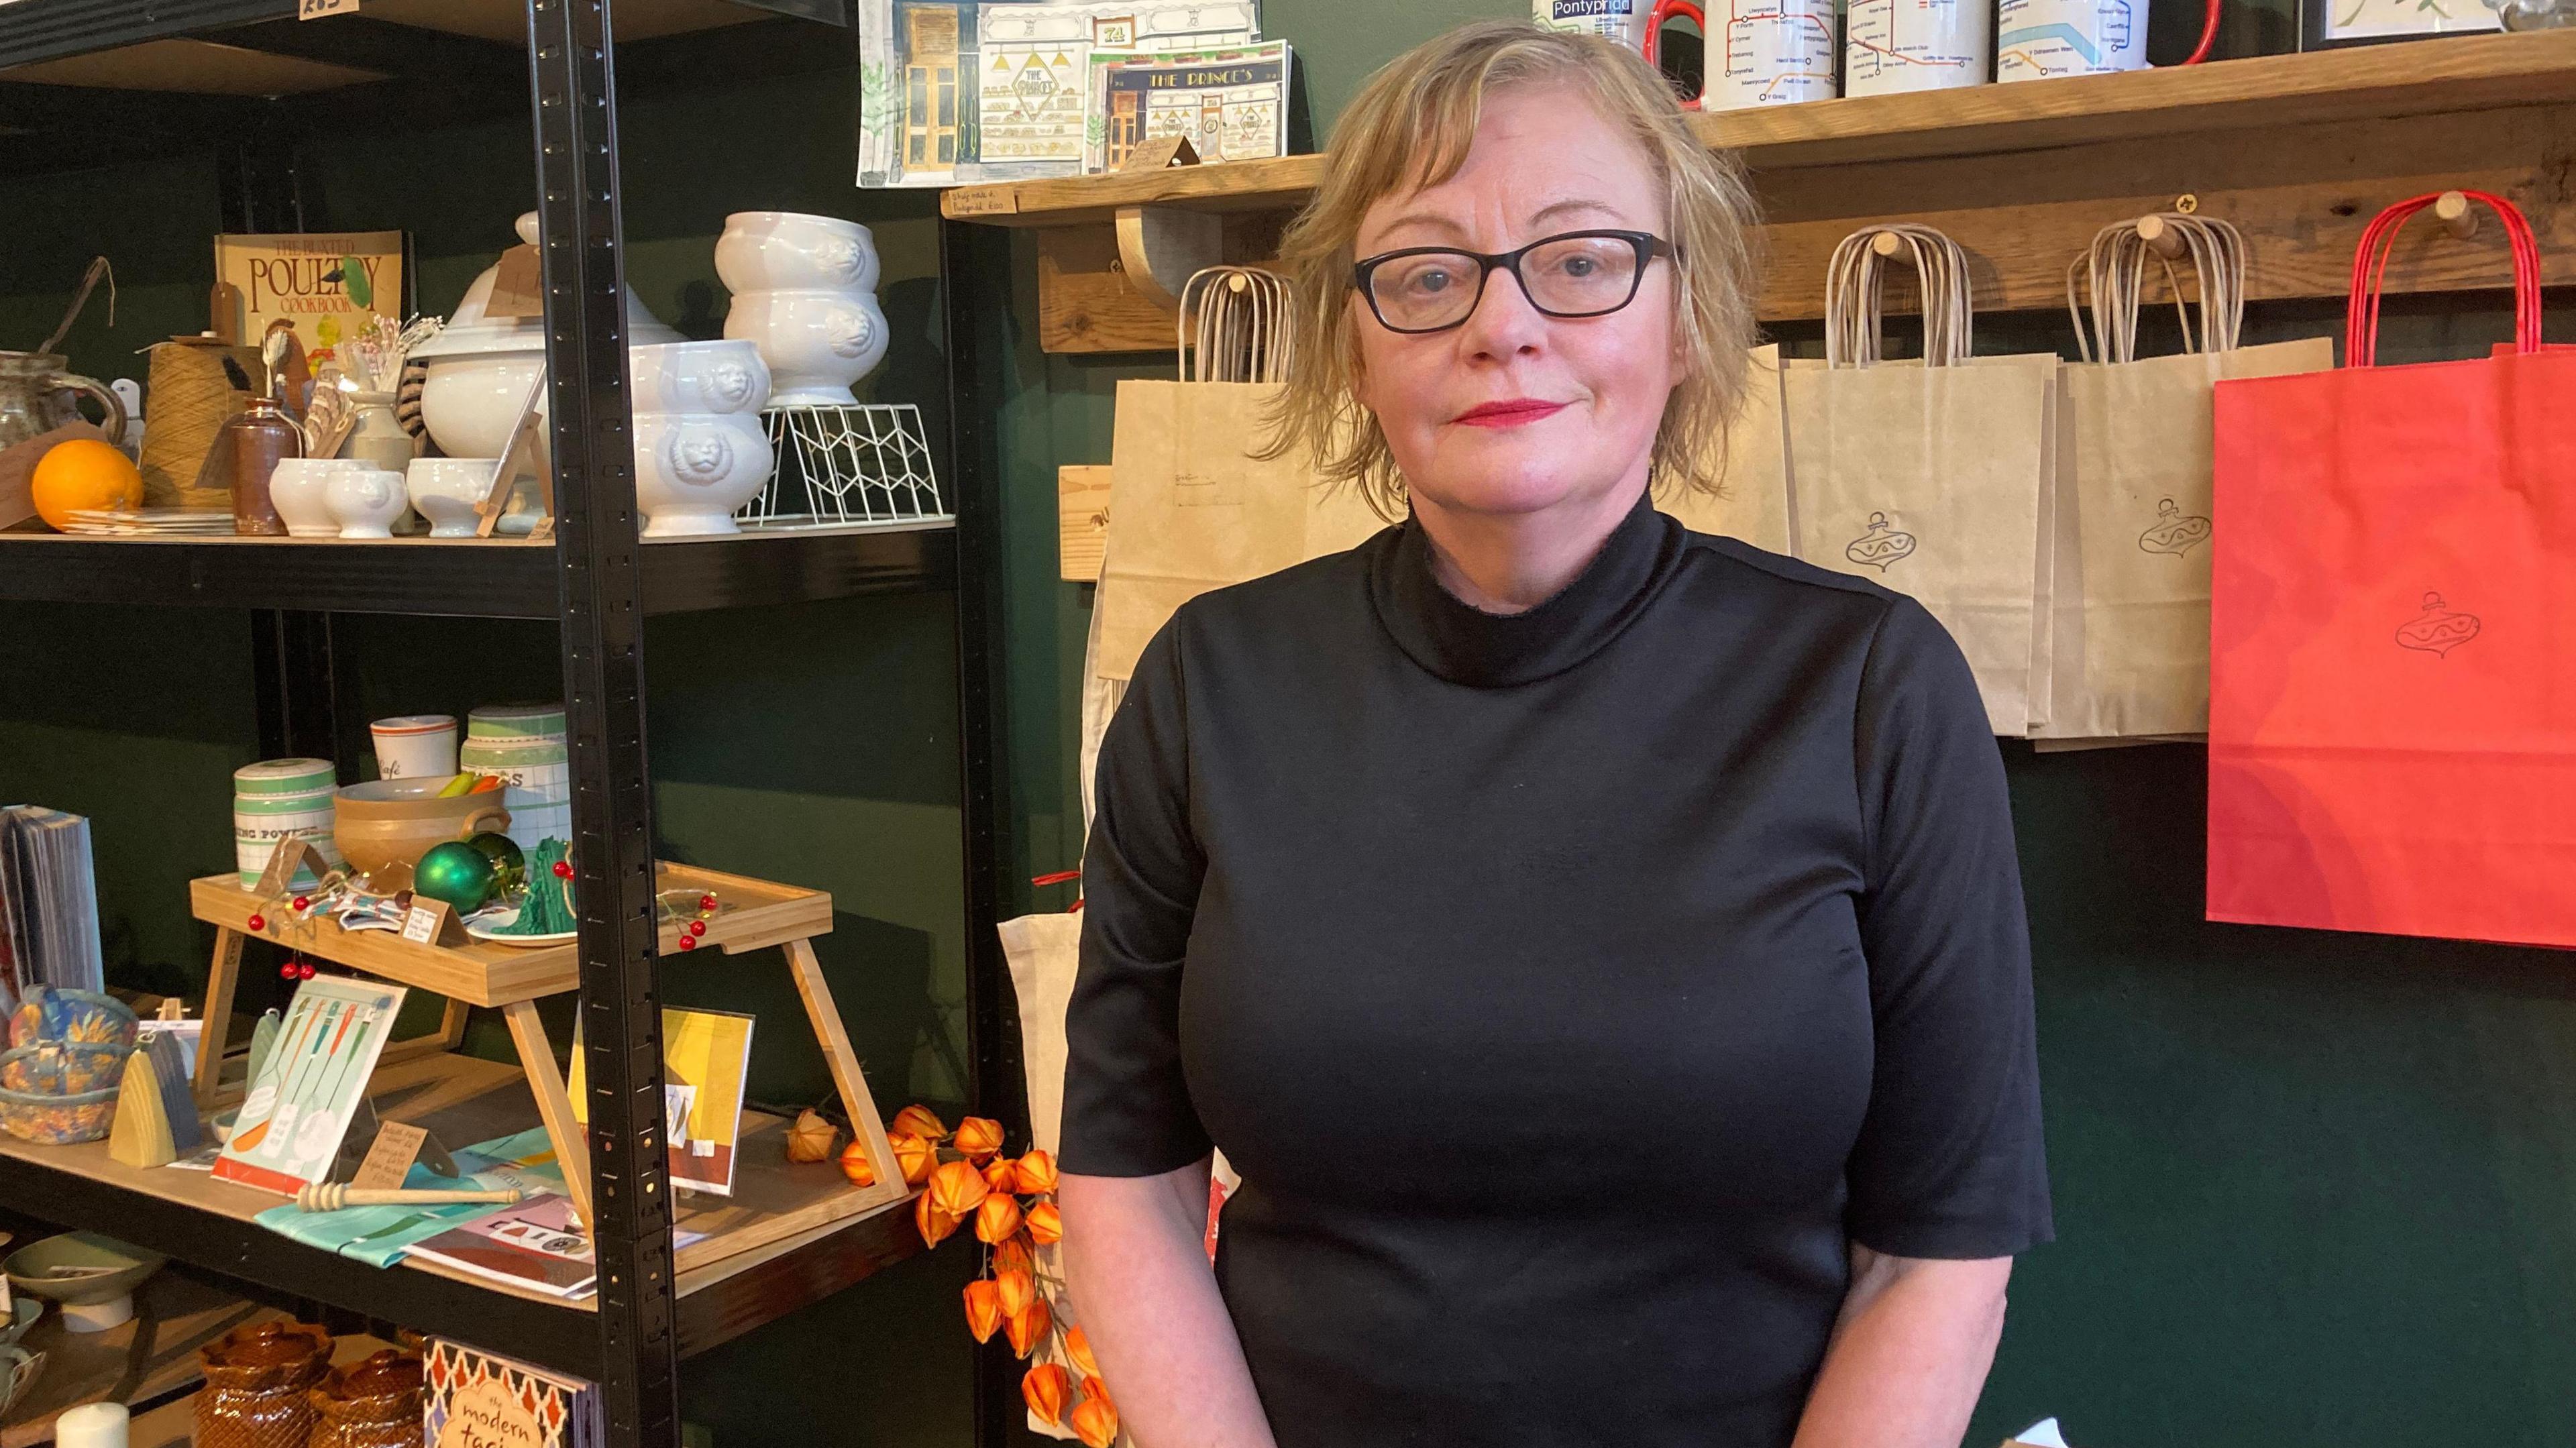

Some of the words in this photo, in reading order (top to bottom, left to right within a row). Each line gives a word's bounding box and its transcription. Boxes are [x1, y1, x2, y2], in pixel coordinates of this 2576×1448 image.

[1555, 0, 1629, 15] Pontypridd
[1104, 27, 1125, 42] 74
[1148, 74, 1178, 87] THE
[1186, 68, 1254, 87] PRINCE'S
[276, 240, 300, 256] THE
[303, 239, 354, 256] BUXTED
[248, 257, 382, 313] POULTY
[280, 297, 352, 313] COOKBOOK
[489, 1396, 502, 1408] the
[463, 1405, 529, 1442] modern
